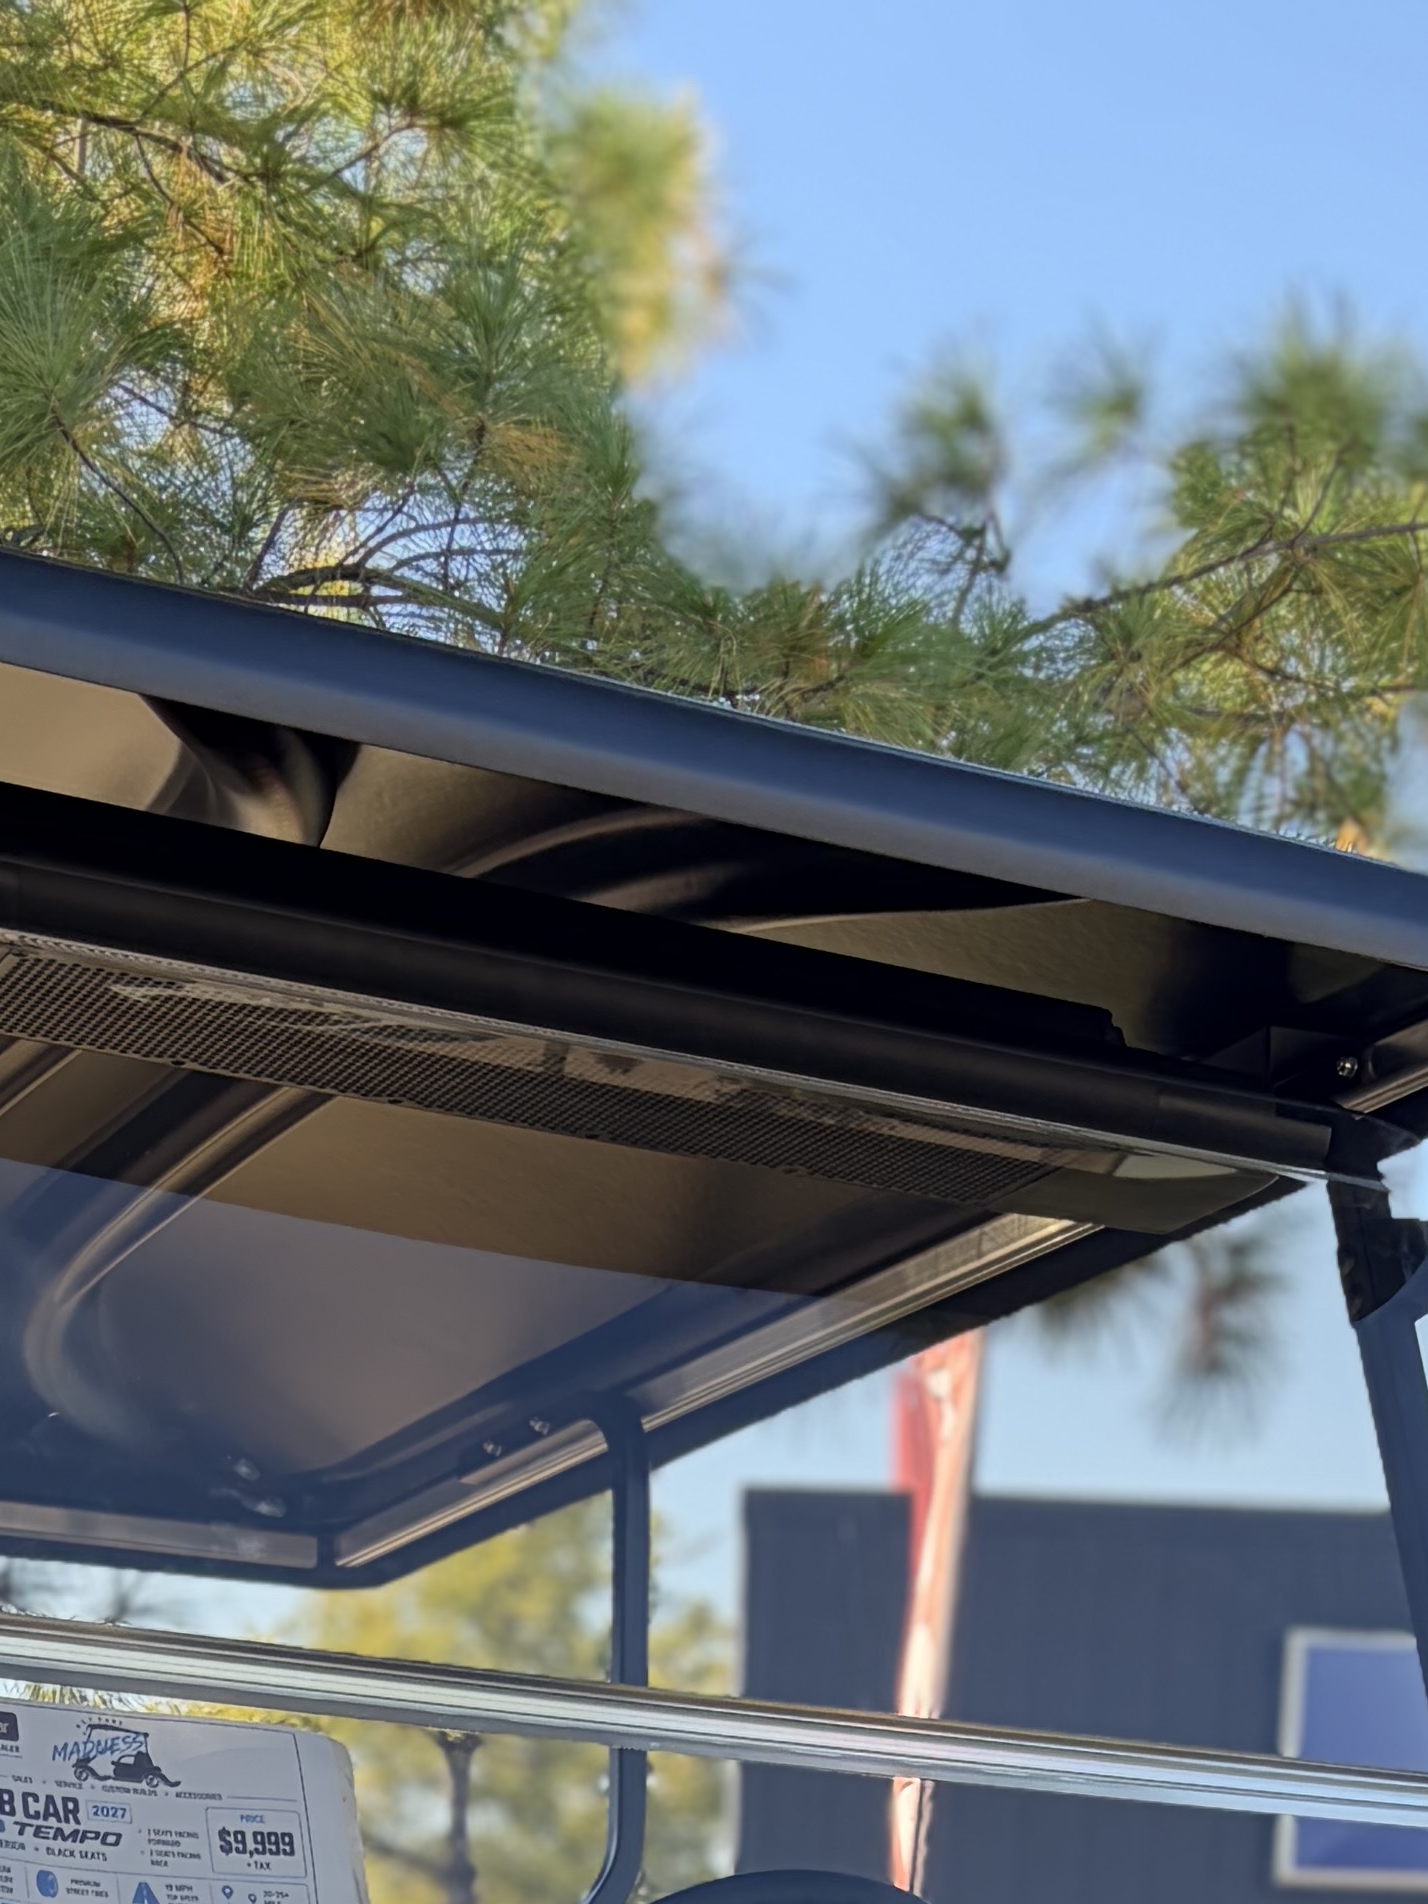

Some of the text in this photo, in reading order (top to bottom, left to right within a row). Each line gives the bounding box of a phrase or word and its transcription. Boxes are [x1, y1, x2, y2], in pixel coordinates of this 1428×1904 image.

[52, 1733, 145, 1762] MADNESS
[20, 1790, 82, 1826] CAR
[91, 1804, 129, 1821] 2027
[239, 1814, 265, 1824] PRICE
[12, 1819, 124, 1847] TEMPO
[217, 1826, 296, 1861] $9,999
[45, 1845, 76, 1858] BLACK
[78, 1849, 107, 1861] SEATS
[253, 1860, 272, 1871] TAX
